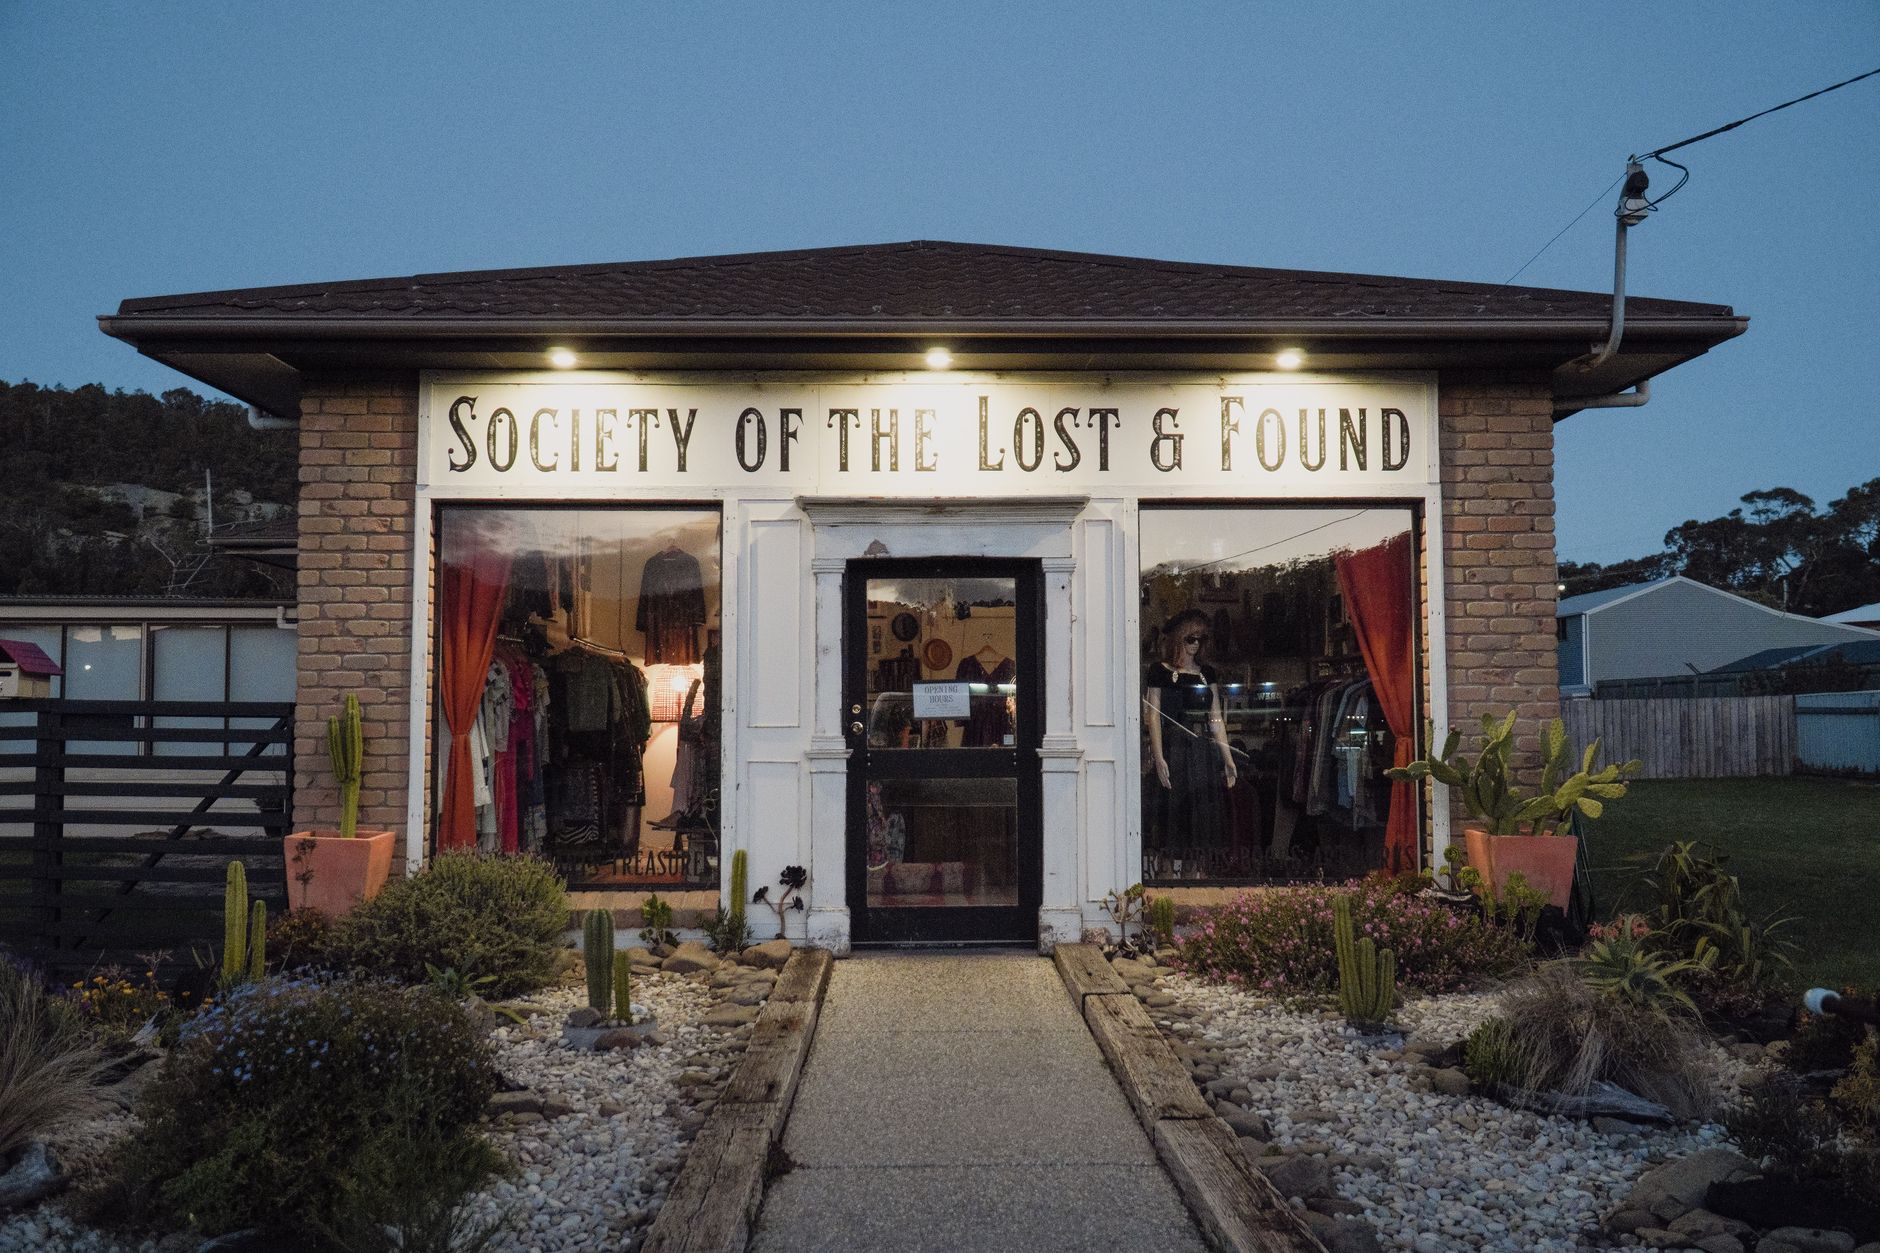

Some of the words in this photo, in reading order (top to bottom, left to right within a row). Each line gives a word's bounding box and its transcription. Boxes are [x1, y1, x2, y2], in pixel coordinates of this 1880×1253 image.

[448, 396, 698, 473] SOCIETY
[735, 407, 803, 472] OF
[827, 408, 938, 472] THE
[978, 396, 1120, 472] LOST
[1150, 407, 1184, 472] &
[1220, 396, 1411, 472] FOUND
[924, 685, 958, 694] OPENING
[929, 695, 954, 704] HOURS
